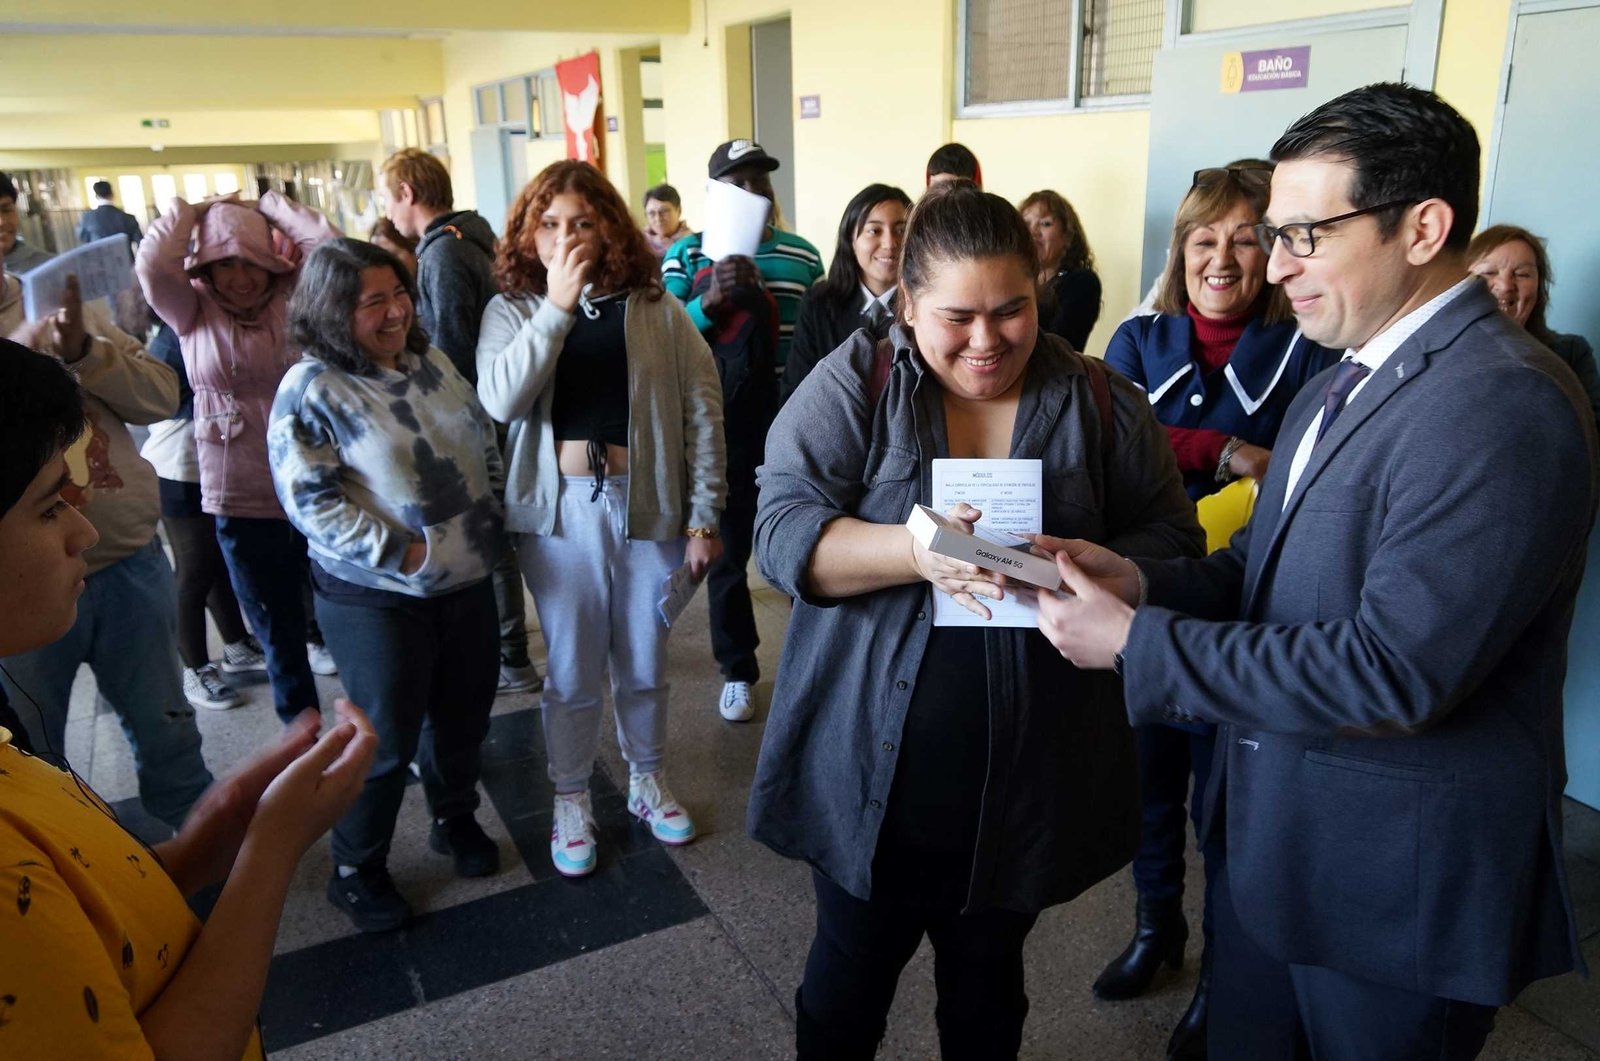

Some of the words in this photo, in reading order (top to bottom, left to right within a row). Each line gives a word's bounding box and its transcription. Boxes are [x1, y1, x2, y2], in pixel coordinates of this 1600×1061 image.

[1258, 55, 1293, 72] BAÑO
[1248, 72, 1280, 81] EDUCACIÓN
[975, 549, 1001, 563] Galaxy
[1000, 556, 1013, 566] A14
[1013, 560, 1024, 569] 5G
